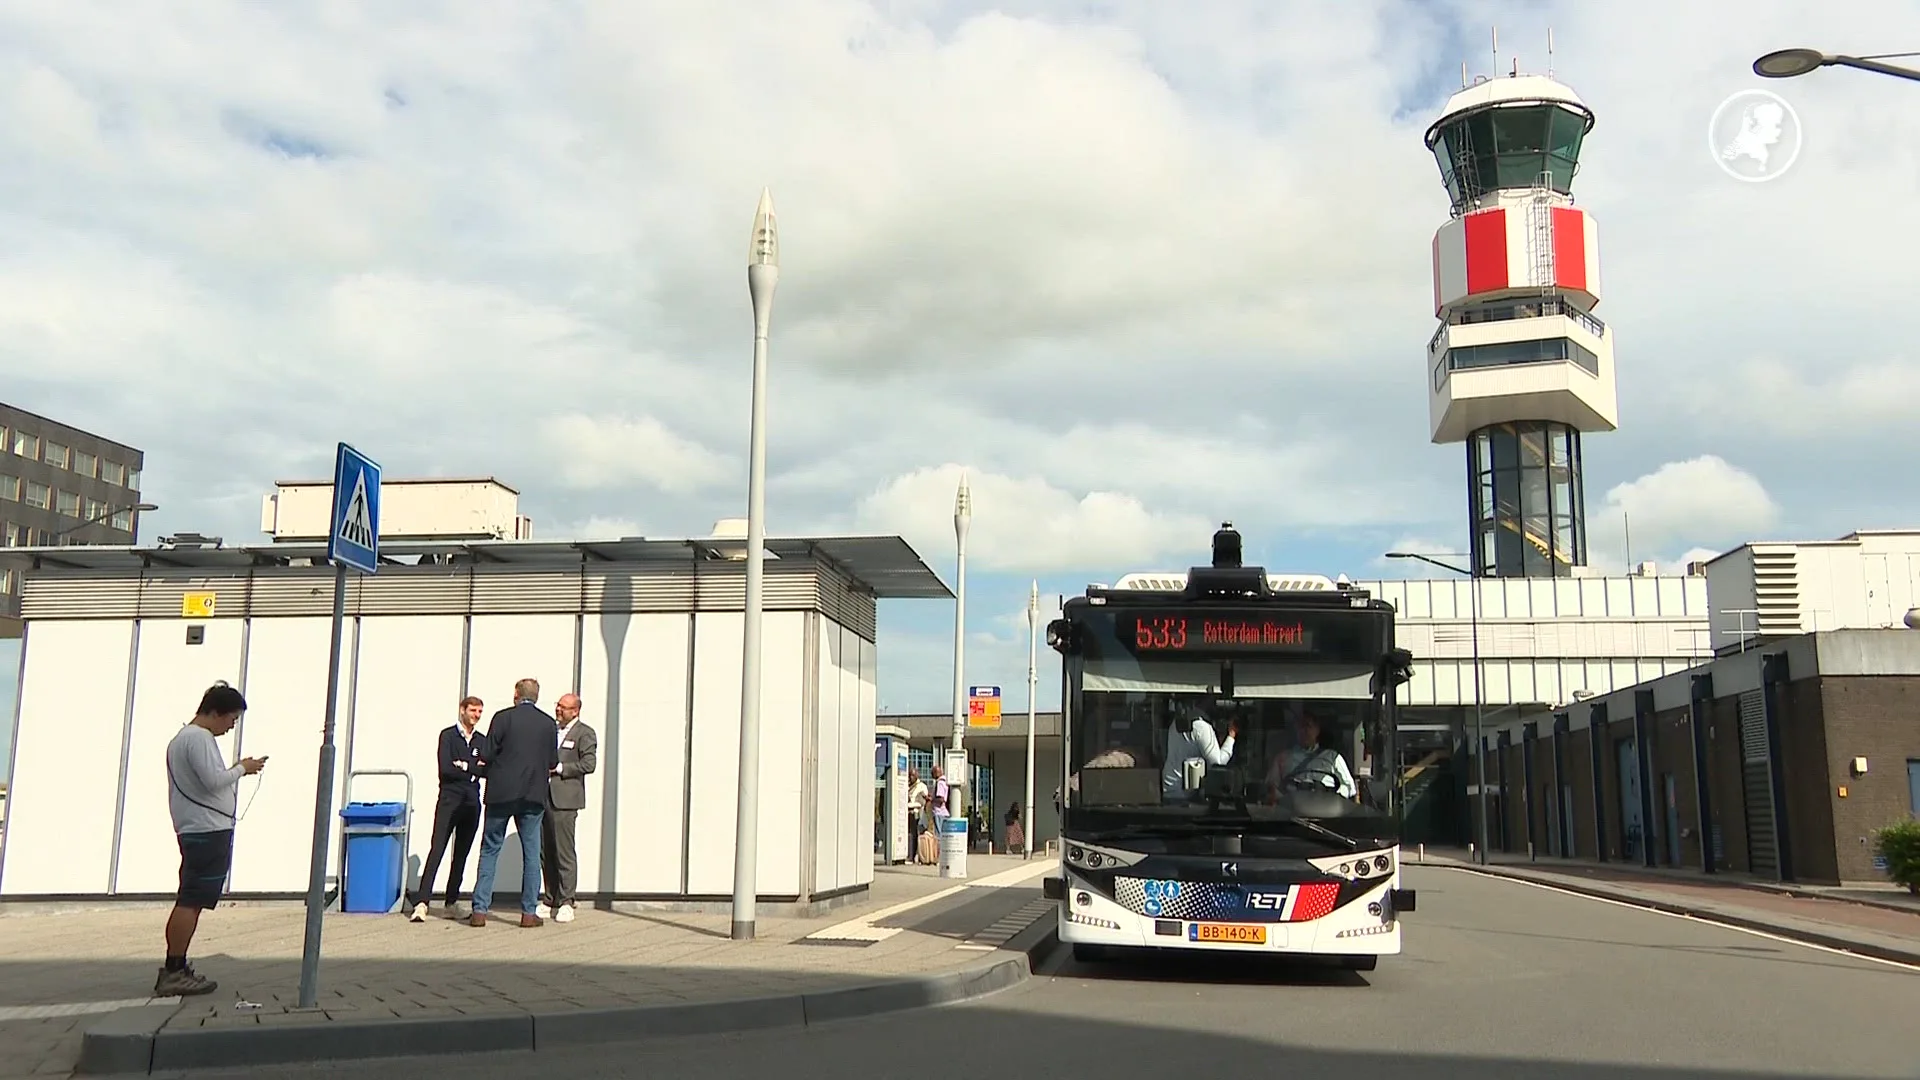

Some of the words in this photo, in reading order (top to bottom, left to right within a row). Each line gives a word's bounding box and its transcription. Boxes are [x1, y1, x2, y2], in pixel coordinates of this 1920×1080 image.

[1136, 618, 1187, 648] 533
[1203, 621, 1260, 644] Rotterdam
[1263, 621, 1303, 644] Airport
[1250, 892, 1286, 910] RET
[1203, 927, 1260, 940] BB-140-K
